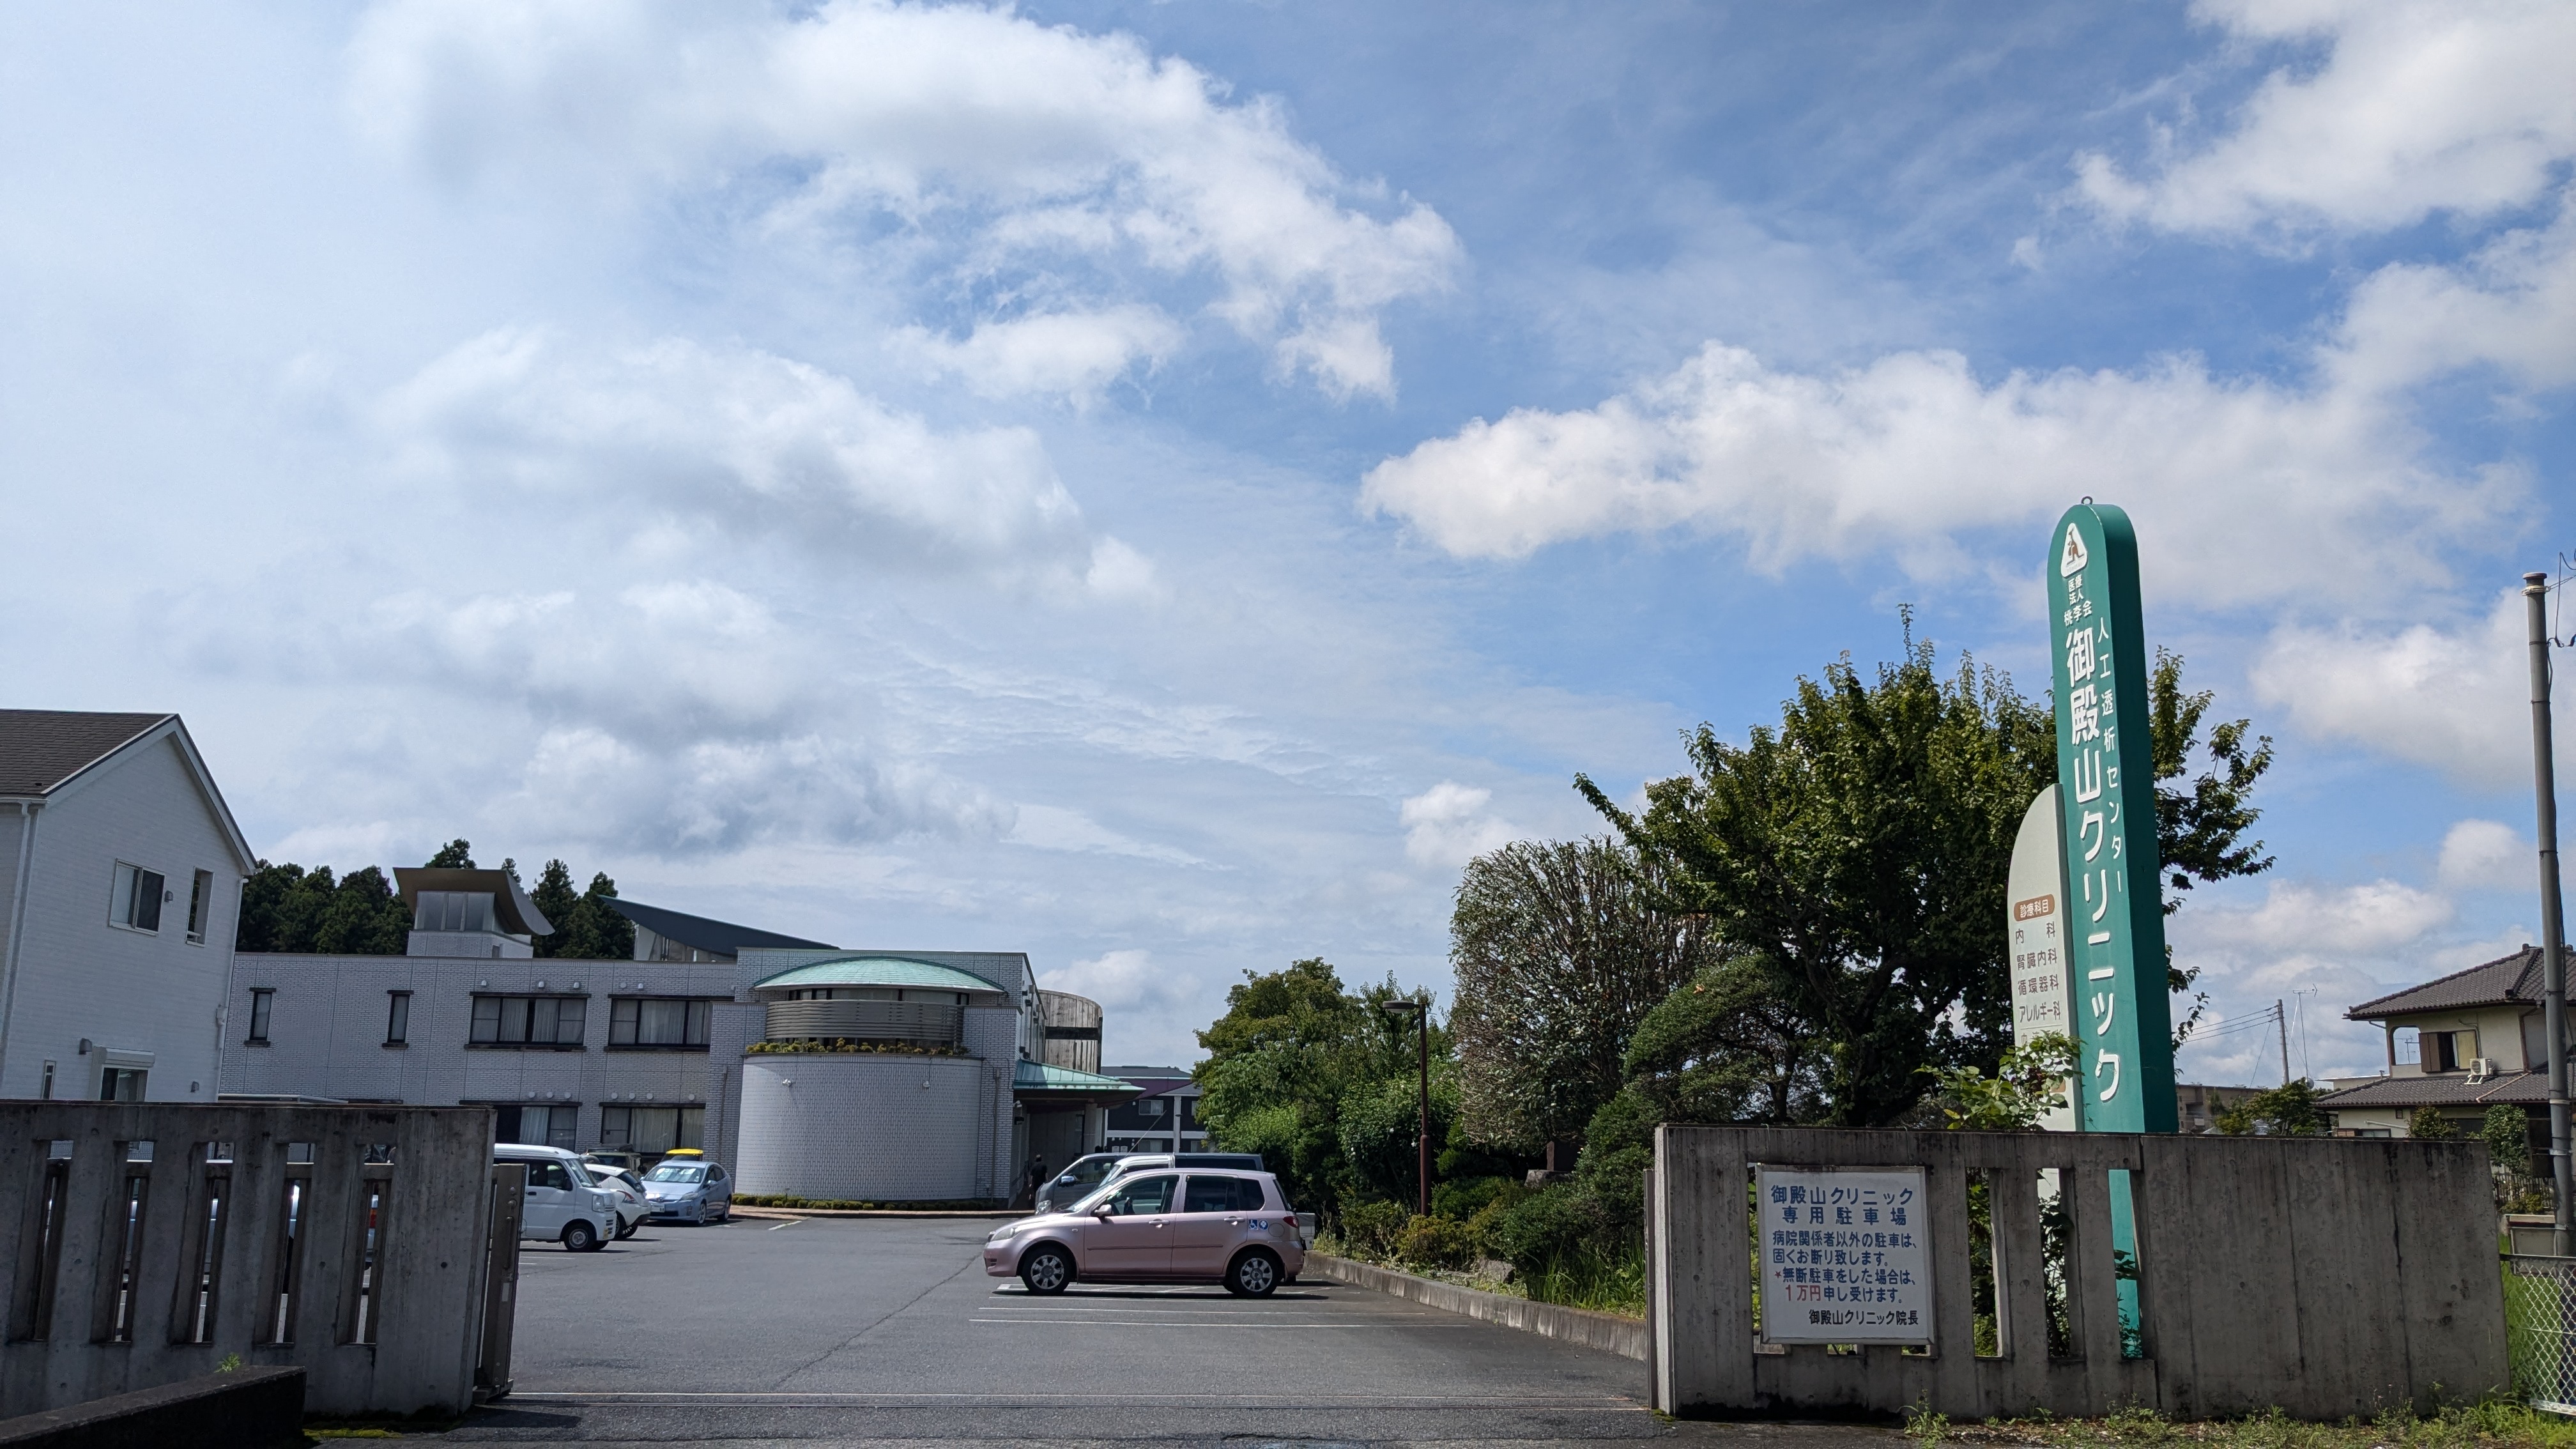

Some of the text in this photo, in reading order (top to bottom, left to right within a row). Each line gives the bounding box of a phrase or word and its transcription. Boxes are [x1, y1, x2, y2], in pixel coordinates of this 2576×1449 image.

[2068, 574, 2082, 592] 医療
[2069, 588, 2084, 606] 法人
[2064, 600, 2092, 627] 桃李会
[2097, 617, 2122, 893] 人工透析センター
[2066, 627, 2120, 1102] 御殿山クリニック
[2020, 899, 2049, 918] 診療科目
[2016, 947, 2057, 970] 腎臓内科
[2018, 974, 2059, 996] 循環器科
[2019, 1000, 2061, 1023] アレルギー科
[1770, 1184, 1913, 1206] 御殿山クリニック
[1782, 1206, 1906, 1226] 専用駐車場
[1772, 1230, 1917, 1249] 病院関係者以外の駐車は、
[1772, 1248, 1889, 1266] 固くお断り致します。
[1809, 1309, 1919, 1326] 御殿山クリニック院長
